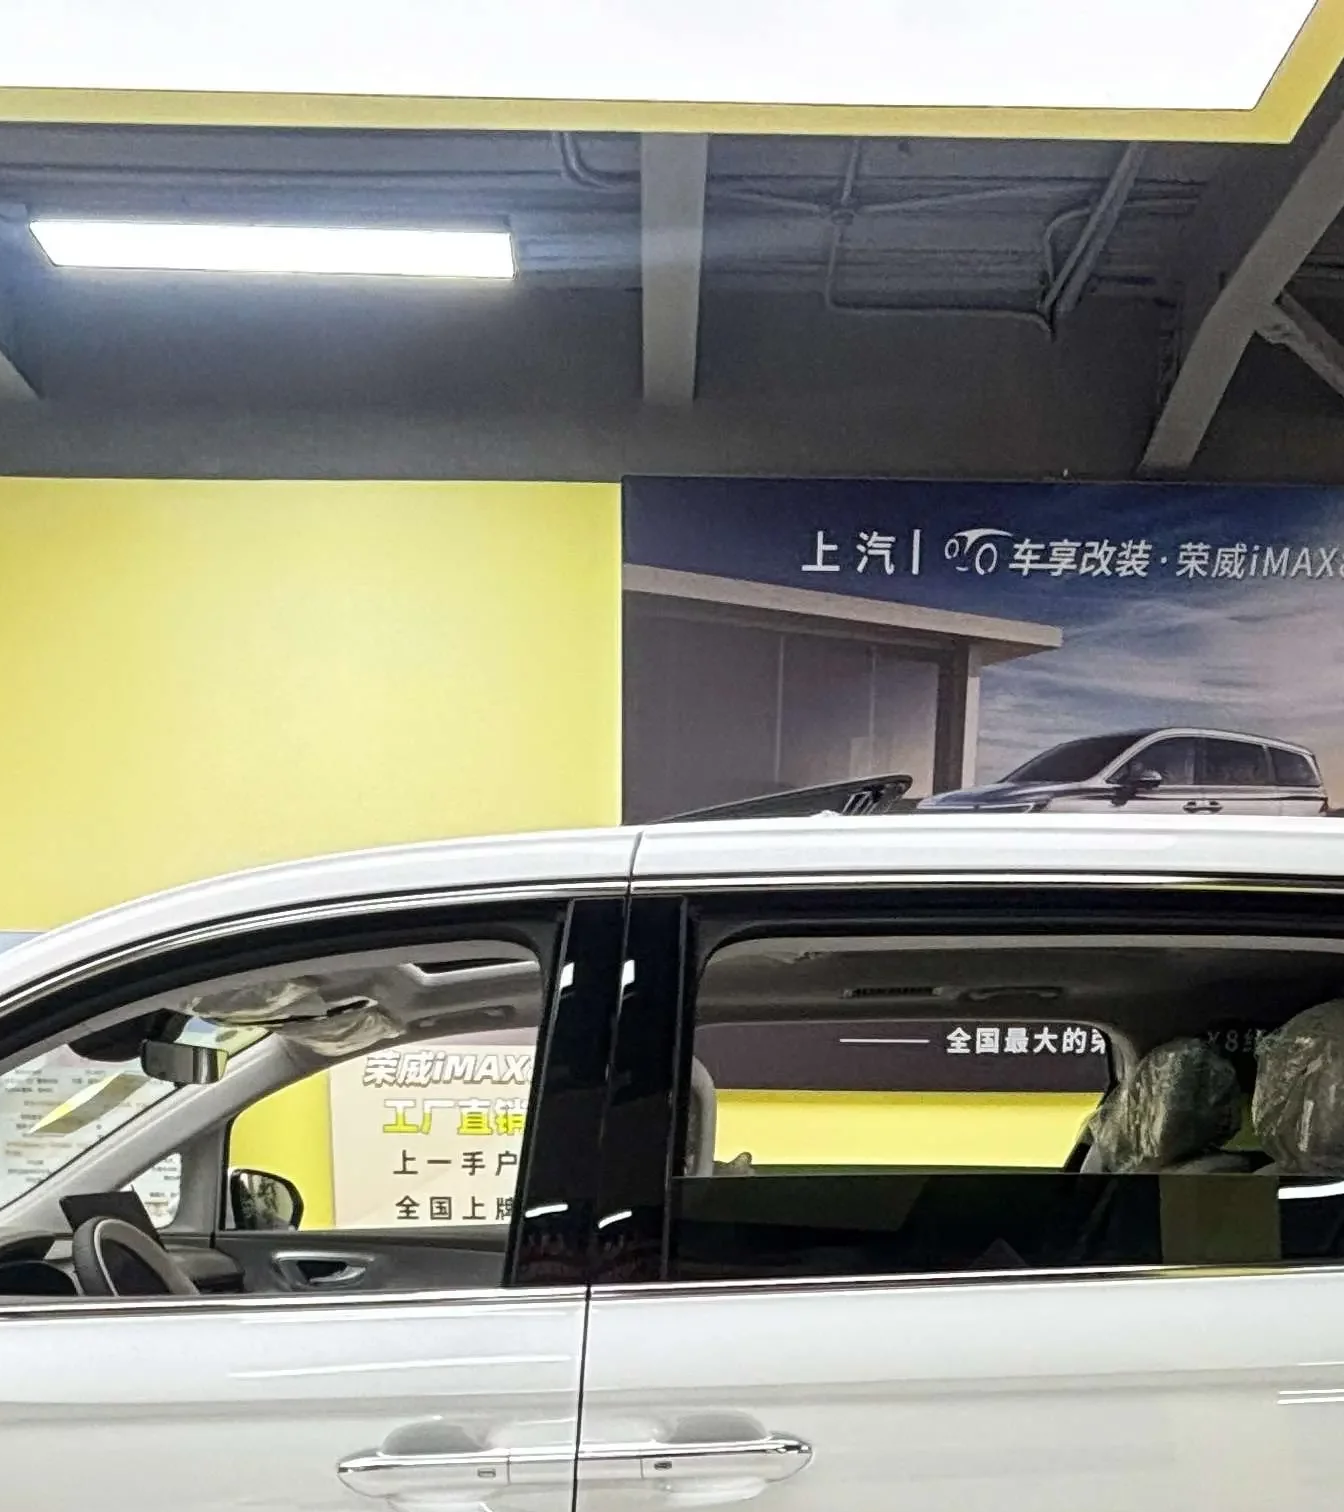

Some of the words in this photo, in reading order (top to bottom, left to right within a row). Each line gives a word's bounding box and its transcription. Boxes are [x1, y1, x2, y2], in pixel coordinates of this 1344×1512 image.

[363, 1050, 532, 1087] 荣威iMAX
[382, 1096, 528, 1136] 工厂直销
